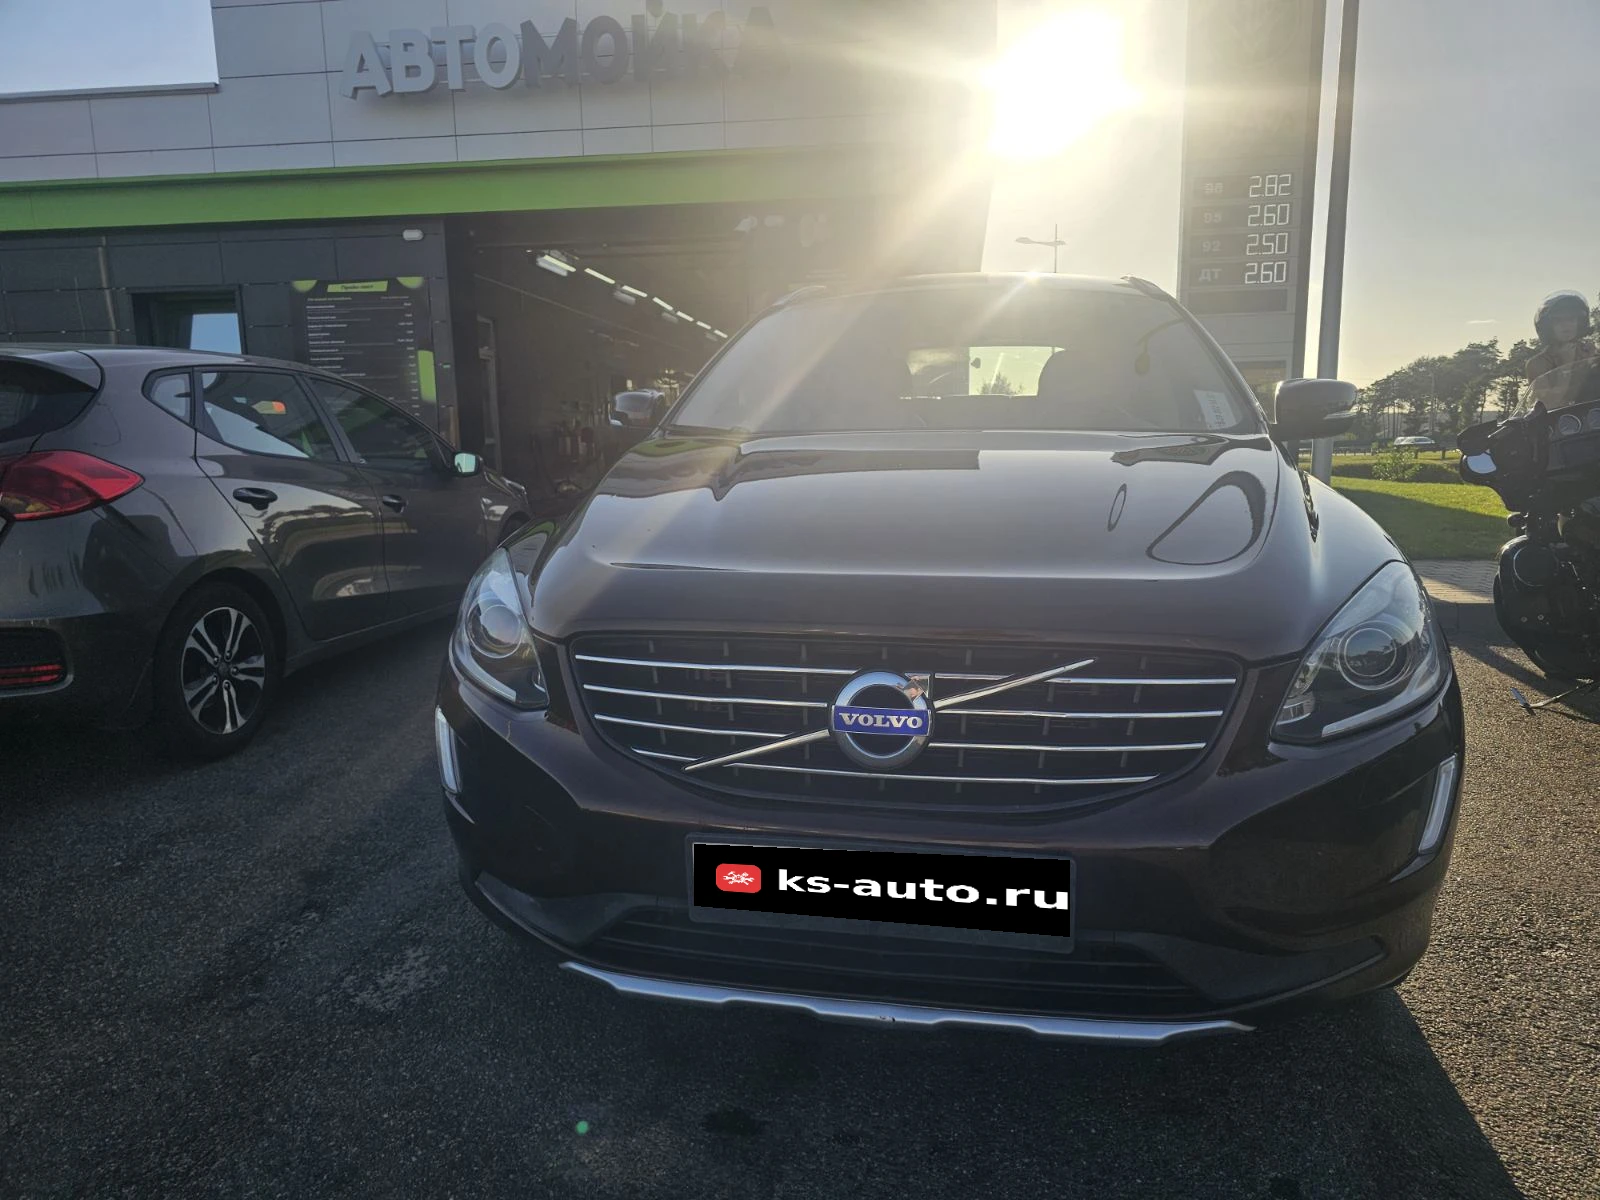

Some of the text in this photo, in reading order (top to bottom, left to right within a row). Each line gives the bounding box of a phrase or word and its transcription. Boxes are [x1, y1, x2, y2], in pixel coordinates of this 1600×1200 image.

[1249, 174, 1292, 198] 2.82
[1247, 203, 1290, 227] 2.60
[1246, 232, 1288, 255] 2.50
[1198, 261, 1287, 284] ДТ 2.60
[839, 712, 923, 729] VOLVO
